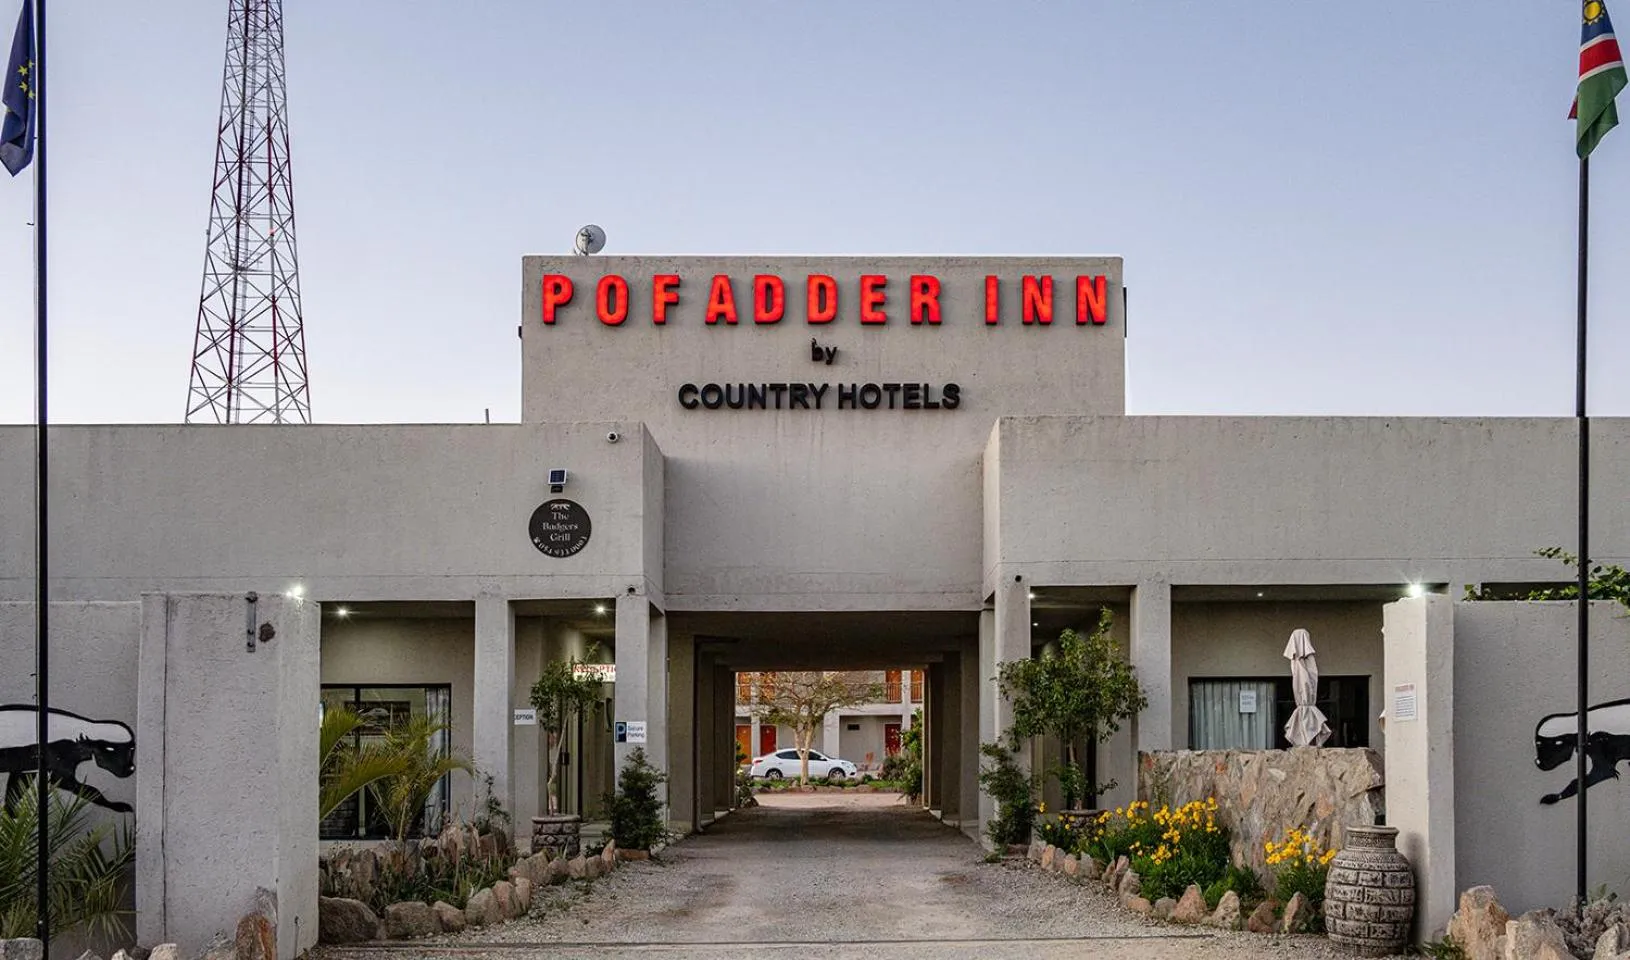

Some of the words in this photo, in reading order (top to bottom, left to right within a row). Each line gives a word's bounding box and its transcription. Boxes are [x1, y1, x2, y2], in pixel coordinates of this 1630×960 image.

[542, 274, 942, 325] POFADDER
[985, 274, 1107, 325] INN
[811, 337, 838, 365] by
[678, 383, 829, 411] COUNTRY
[837, 383, 961, 410] HOTELS
[552, 512, 568, 520] The
[550, 533, 571, 541] Grill
